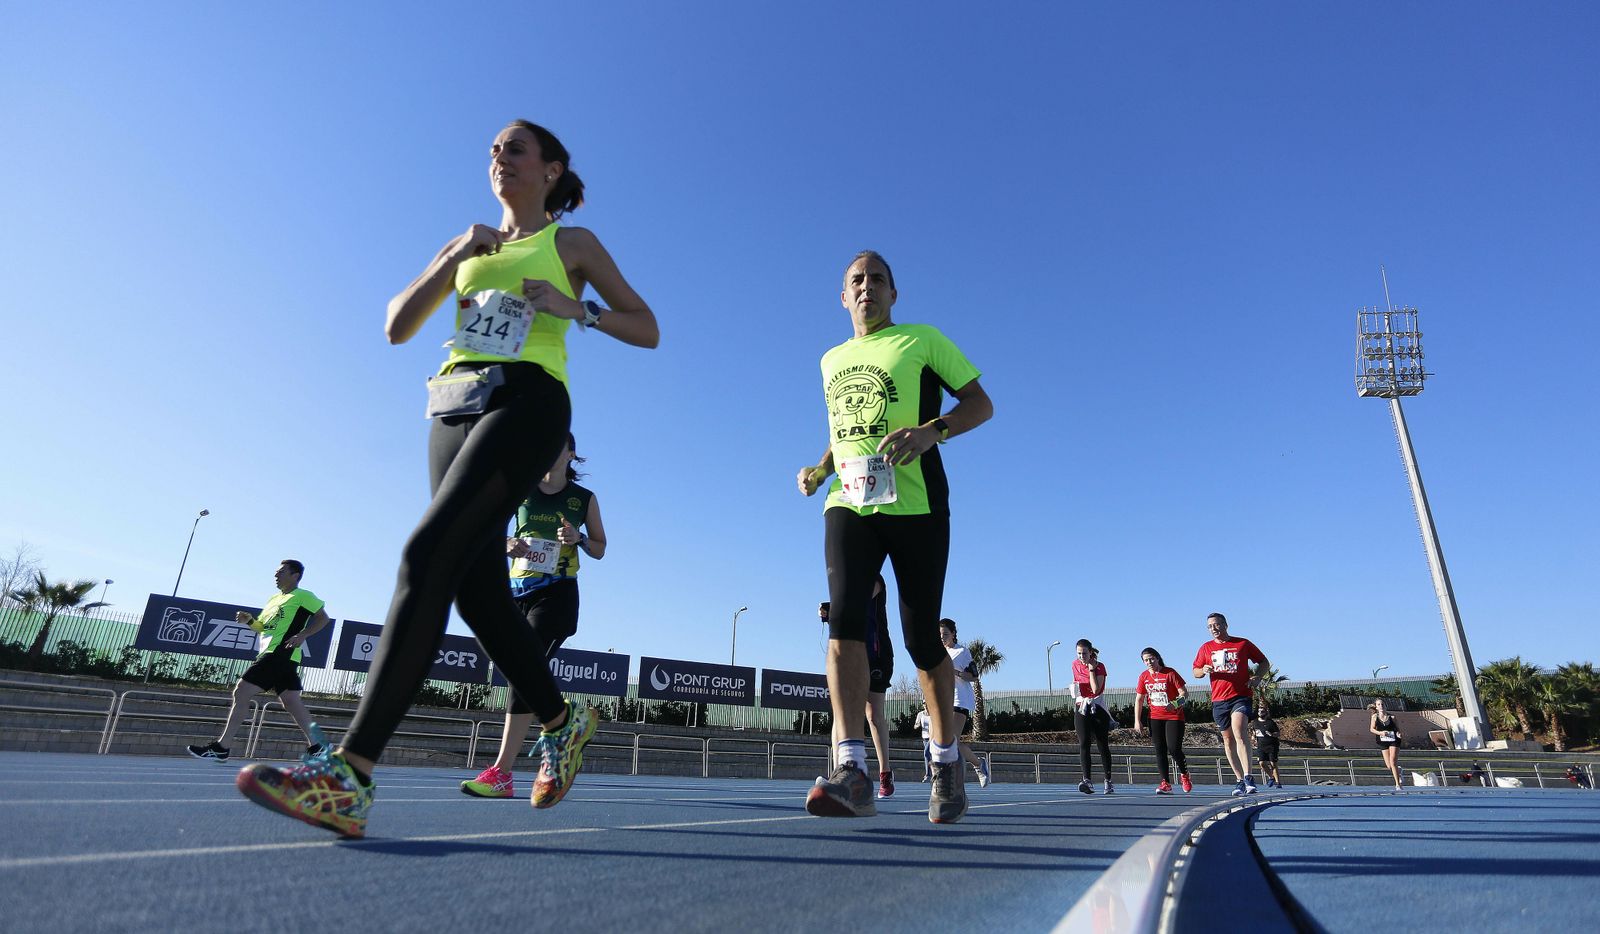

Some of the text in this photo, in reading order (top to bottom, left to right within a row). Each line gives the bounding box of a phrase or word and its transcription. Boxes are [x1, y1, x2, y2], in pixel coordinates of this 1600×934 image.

[465, 313, 510, 340] 214
[864, 364, 899, 403] FUENGIROLA
[836, 424, 884, 439] CAF
[853, 475, 877, 492] 479
[525, 551, 547, 564] 480
[600, 670, 617, 682] 0,0
[673, 672, 746, 690] PONT GRUP
[720, 690, 746, 698] SEGUROS
